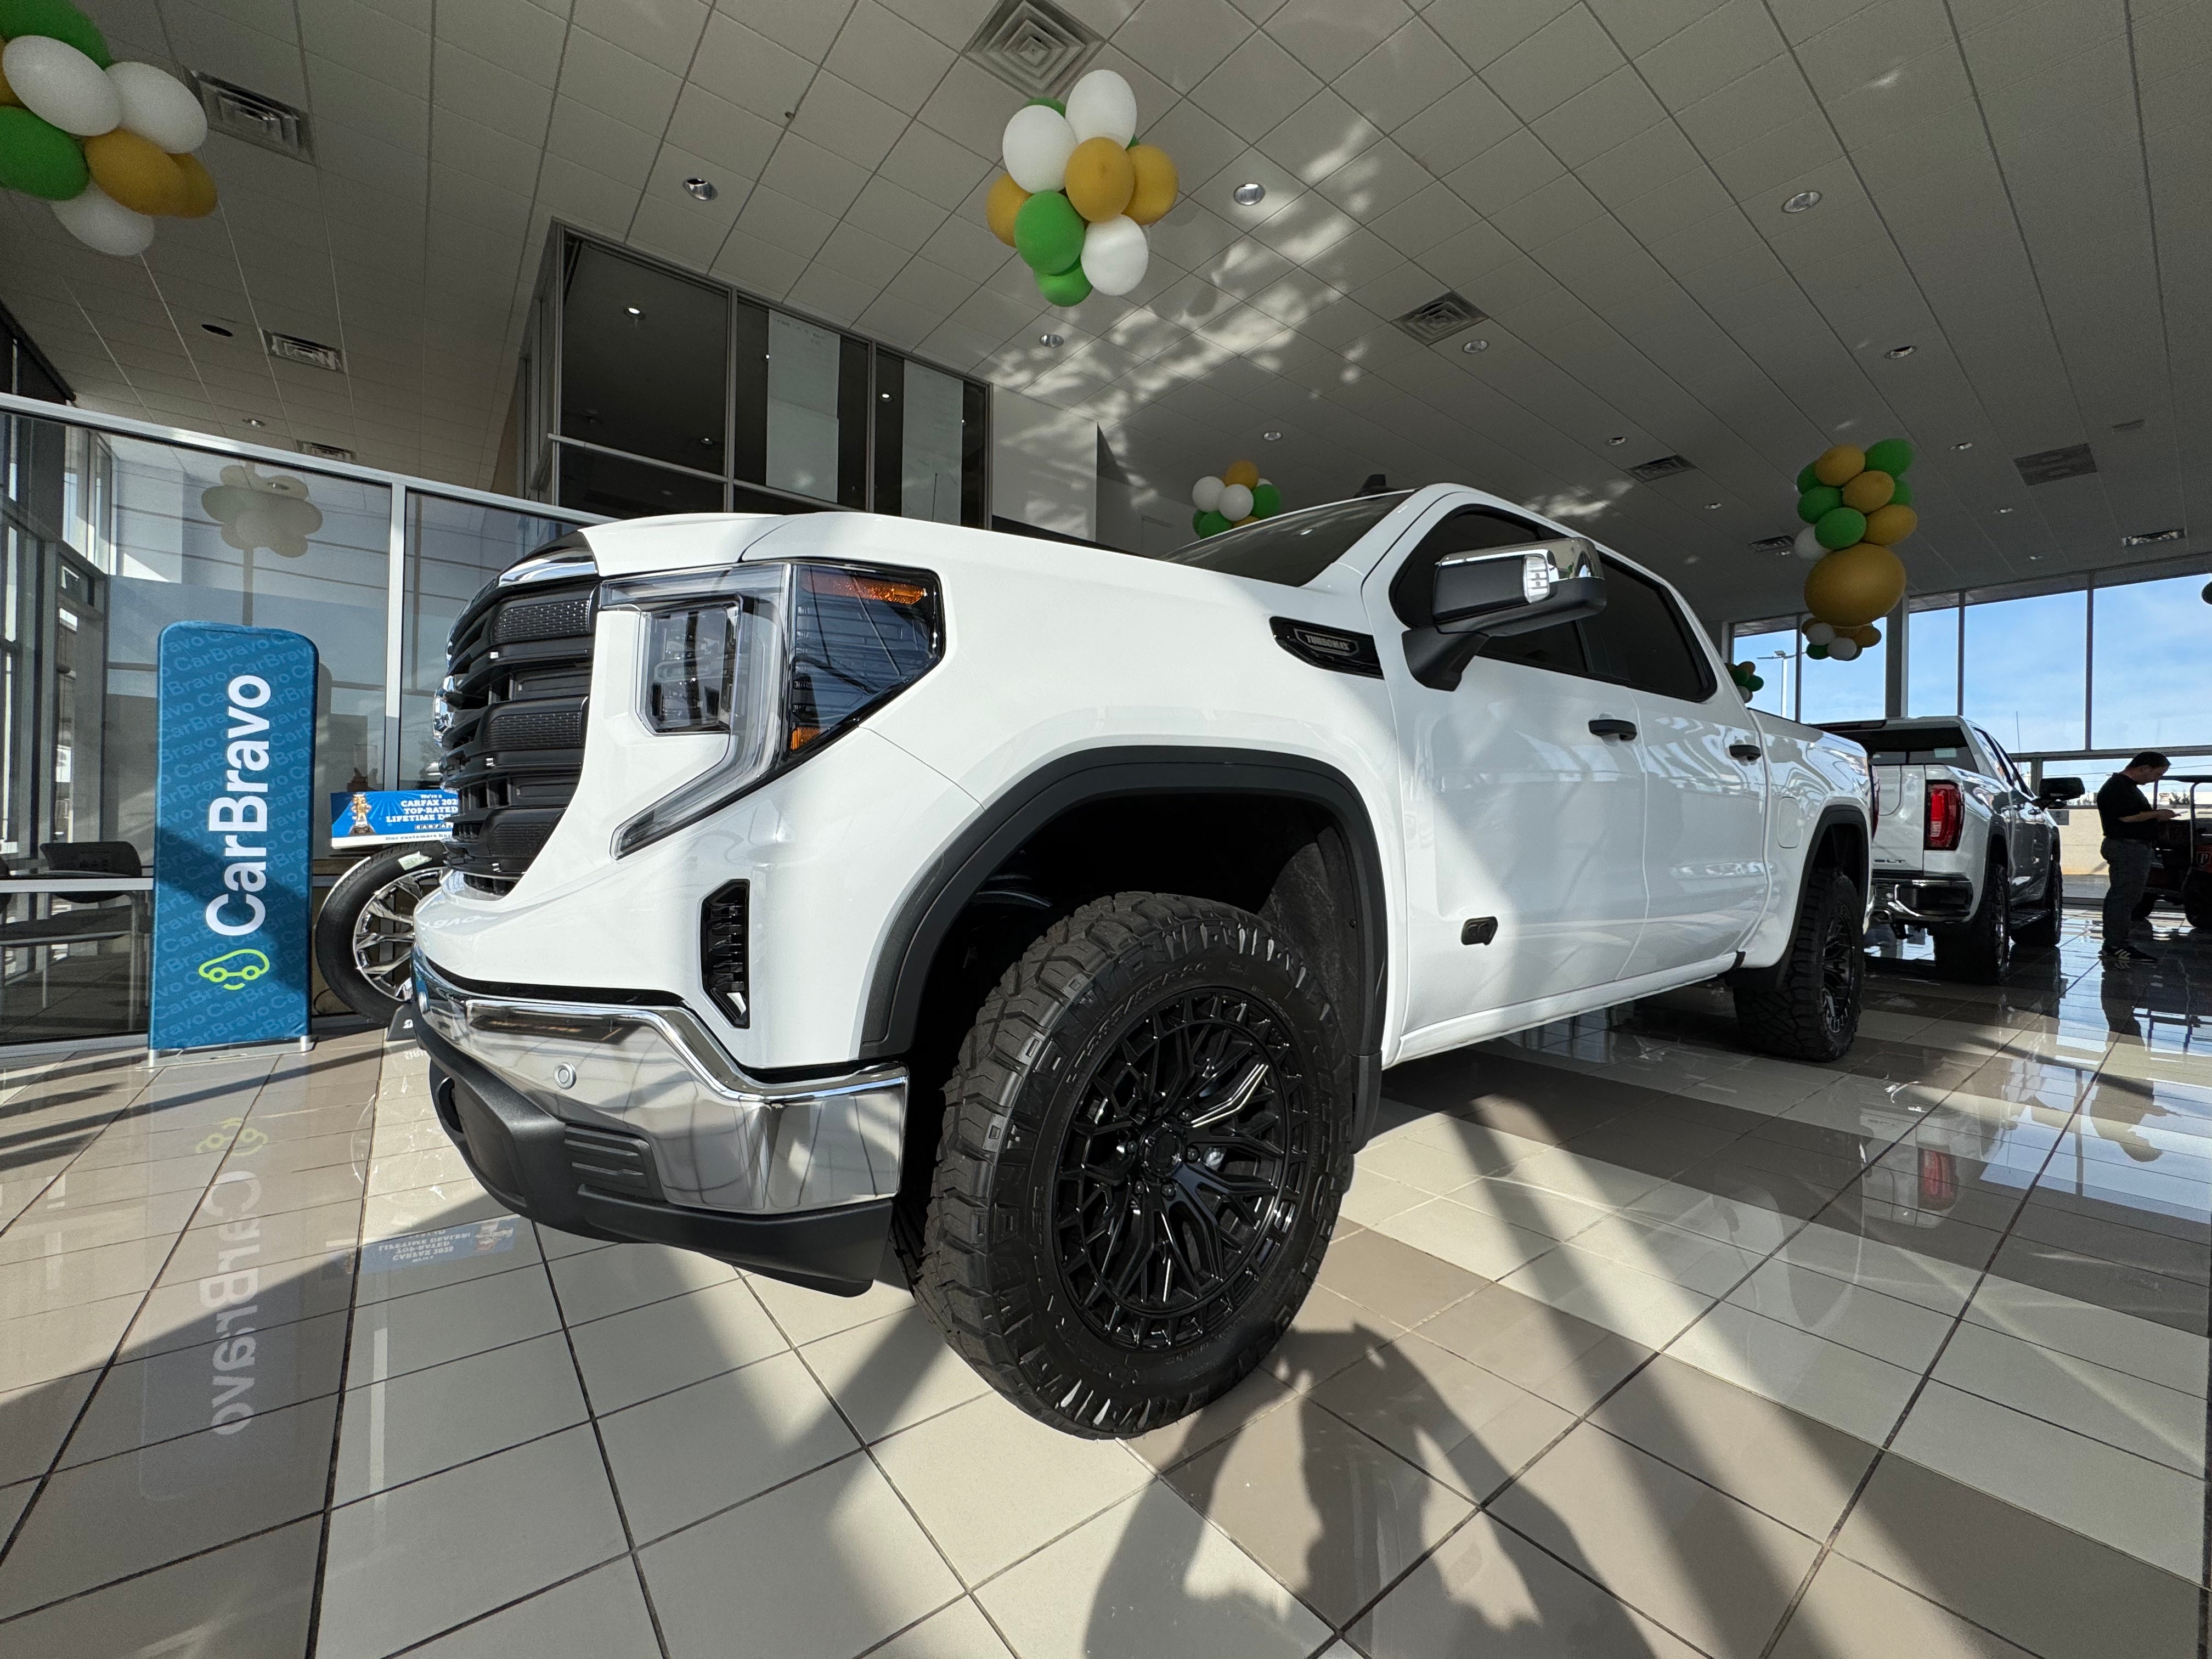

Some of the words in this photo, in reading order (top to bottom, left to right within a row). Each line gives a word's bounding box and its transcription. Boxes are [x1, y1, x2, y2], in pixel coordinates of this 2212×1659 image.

[1305, 634, 1350, 651] TURBOMAX
[205, 675, 271, 936] CarBravo
[386, 814, 435, 823] LIFETIME
